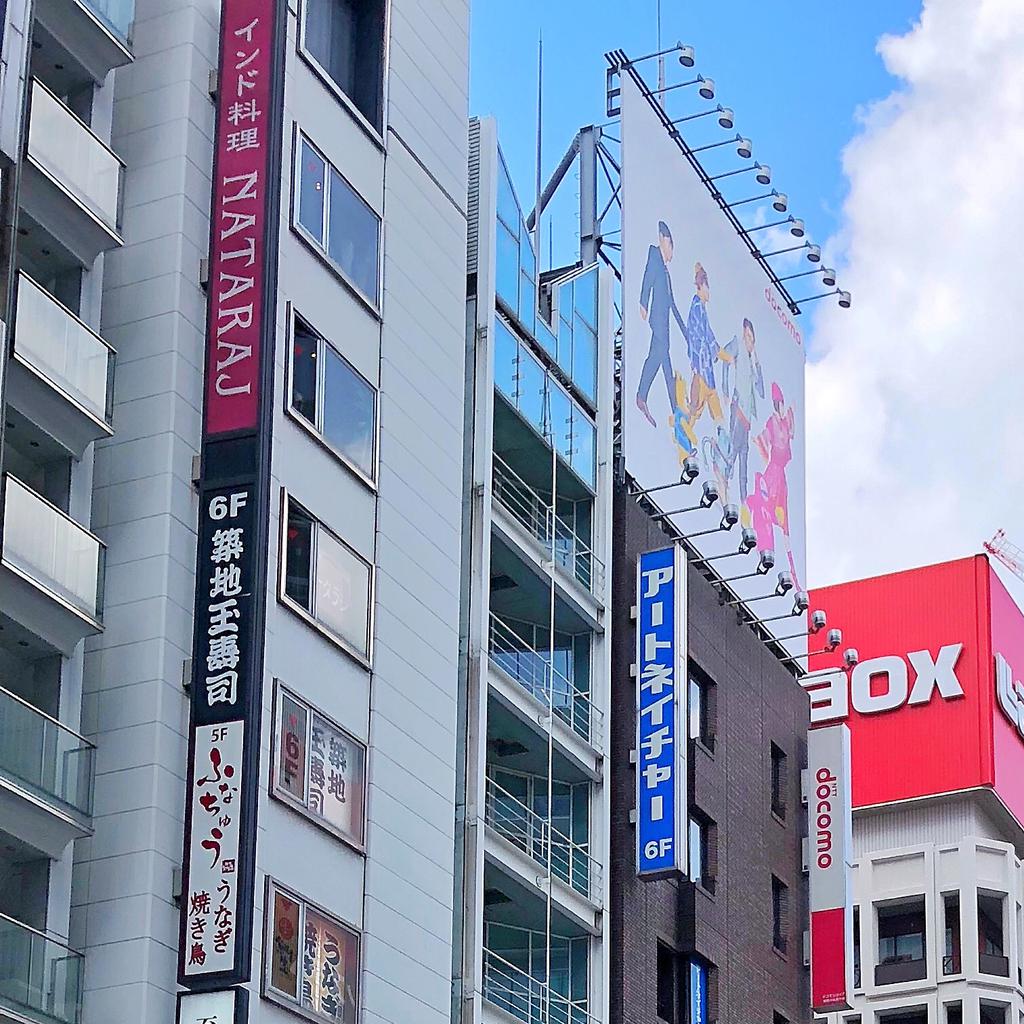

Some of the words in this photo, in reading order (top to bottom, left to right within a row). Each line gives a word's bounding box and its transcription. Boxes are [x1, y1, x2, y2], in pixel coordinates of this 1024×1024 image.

[225, 18, 261, 151] インド料理
[215, 170, 259, 398] NATARAJ
[764, 287, 802, 346] docomo
[208, 491, 248, 521] 6F
[641, 566, 675, 822] アートネイチャー
[211, 728, 228, 743] 5F
[198, 747, 235, 870] ふなちゅう
[644, 836, 674, 862] 6F
[815, 768, 837, 870] docomo
[188, 890, 212, 966] 焼き鳥
[213, 880, 233, 954] うなぎ
[321, 930, 341, 1016] うなぎ
